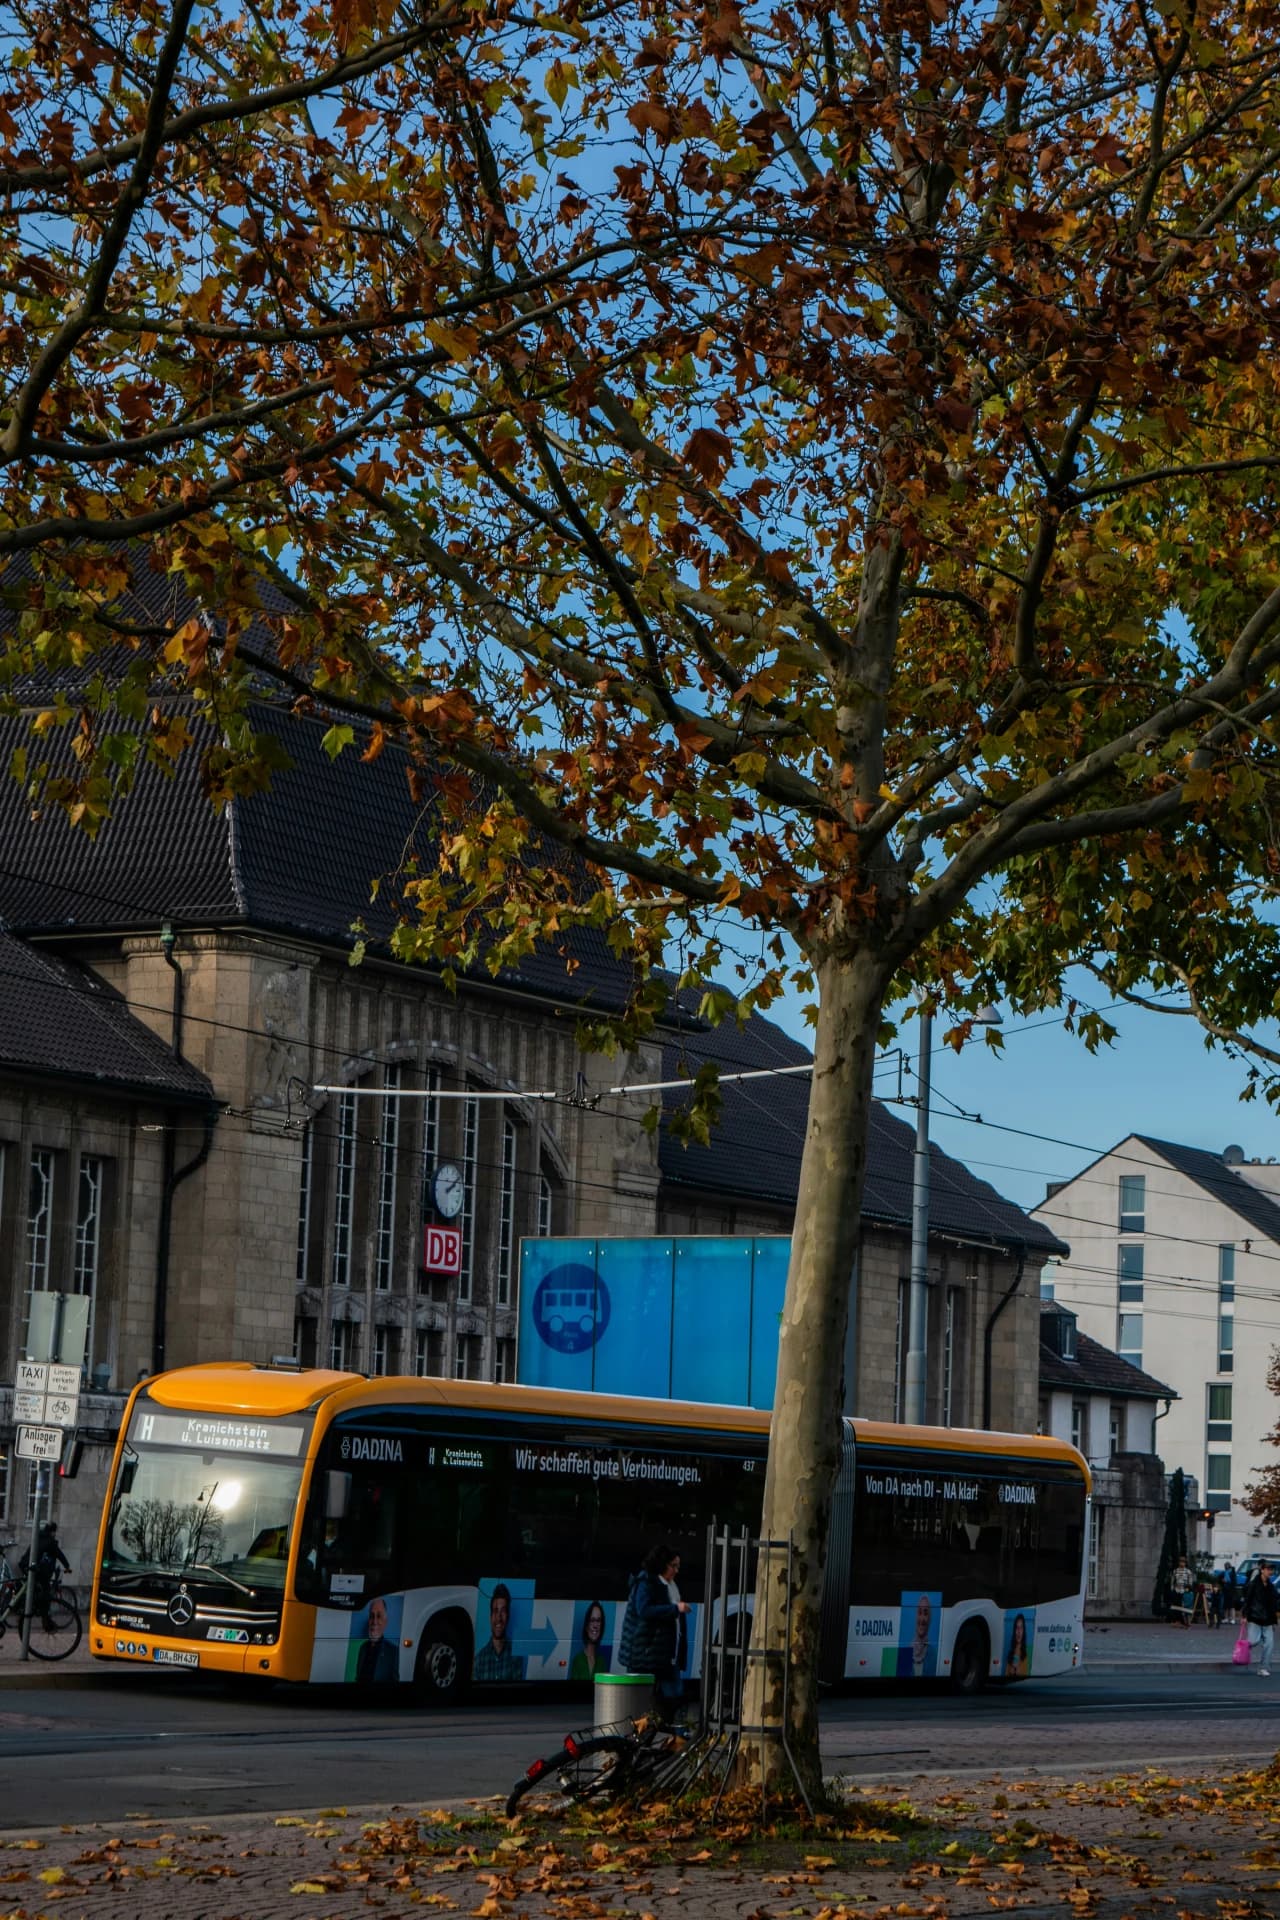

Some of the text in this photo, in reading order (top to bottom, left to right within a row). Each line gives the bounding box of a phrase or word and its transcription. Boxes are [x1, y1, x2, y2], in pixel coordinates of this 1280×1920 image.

[429, 1231, 458, 1267] DB
[21, 1366, 43, 1380] TAXI
[52, 1376, 75, 1385] verkehr
[25, 1430, 57, 1443] Anlieger
[141, 1415, 155, 1441] H
[187, 1419, 267, 1438] Kranichstein
[32, 1443, 47, 1455] frei
[196, 1431, 271, 1450] Luisenplatz
[352, 1437, 403, 1462] DADINA
[428, 1447, 436, 1465] H
[445, 1447, 482, 1460] Kranichstein
[515, 1448, 701, 1487] Wir schaffen gute Verbindungen.
[742, 1460, 755, 1472] 437
[865, 1475, 883, 1495] Von
[885, 1477, 898, 1496] DA
[900, 1478, 922, 1497] nach
[924, 1480, 935, 1498] DI
[943, 1481, 957, 1500] NA
[958, 1482, 979, 1501] klar!
[1004, 1485, 1036, 1504] DADINA
[861, 1619, 894, 1637] DADINA
[1037, 1623, 1072, 1633] www.dadina.de
[159, 1649, 170, 1661] DA
